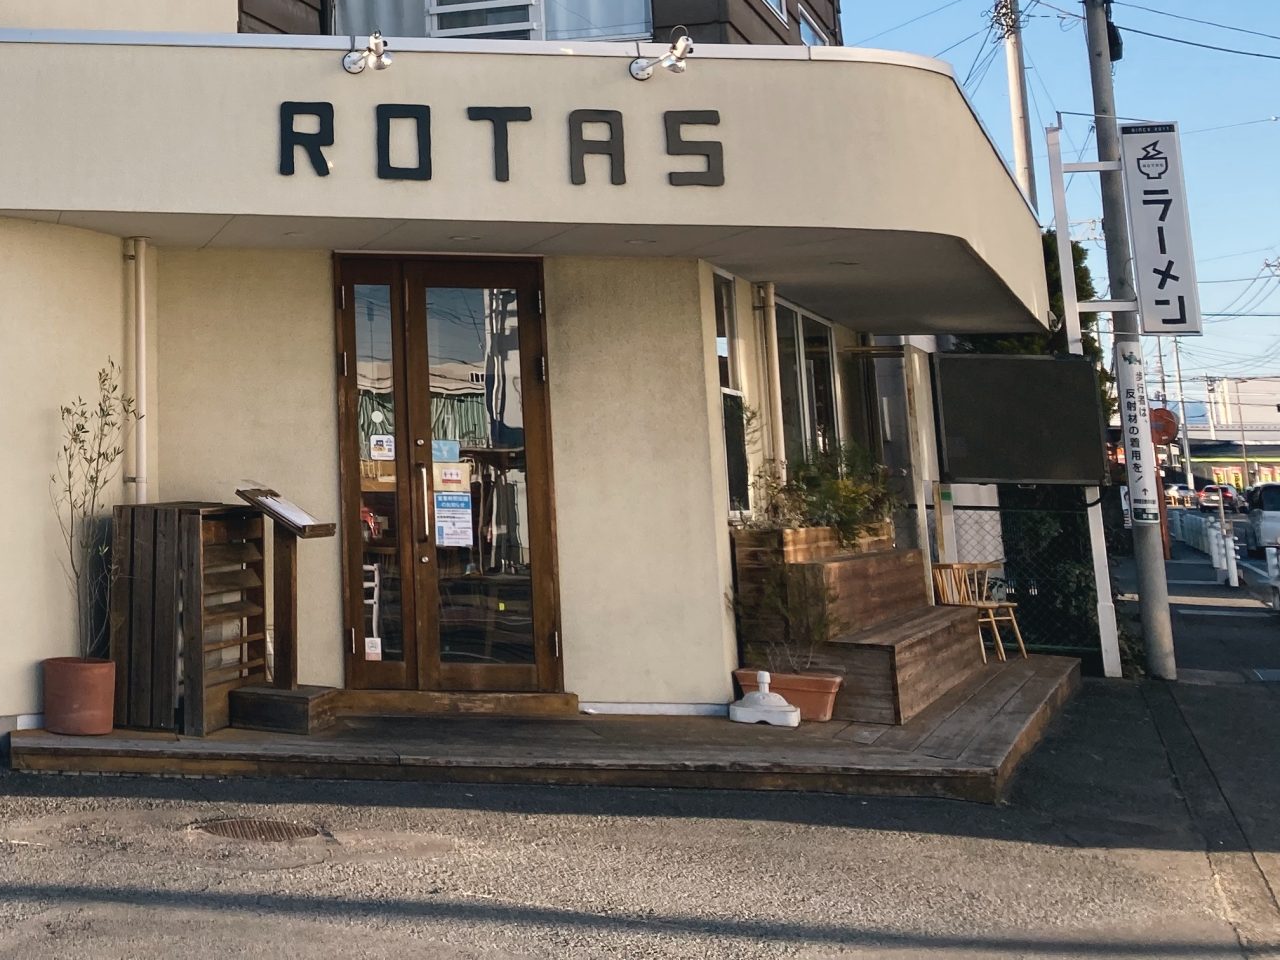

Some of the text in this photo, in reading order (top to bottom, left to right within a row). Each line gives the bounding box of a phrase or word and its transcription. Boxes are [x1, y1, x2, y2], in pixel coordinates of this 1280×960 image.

[278, 100, 726, 187] ROTAS
[1142, 189, 1187, 325] ラーメン
